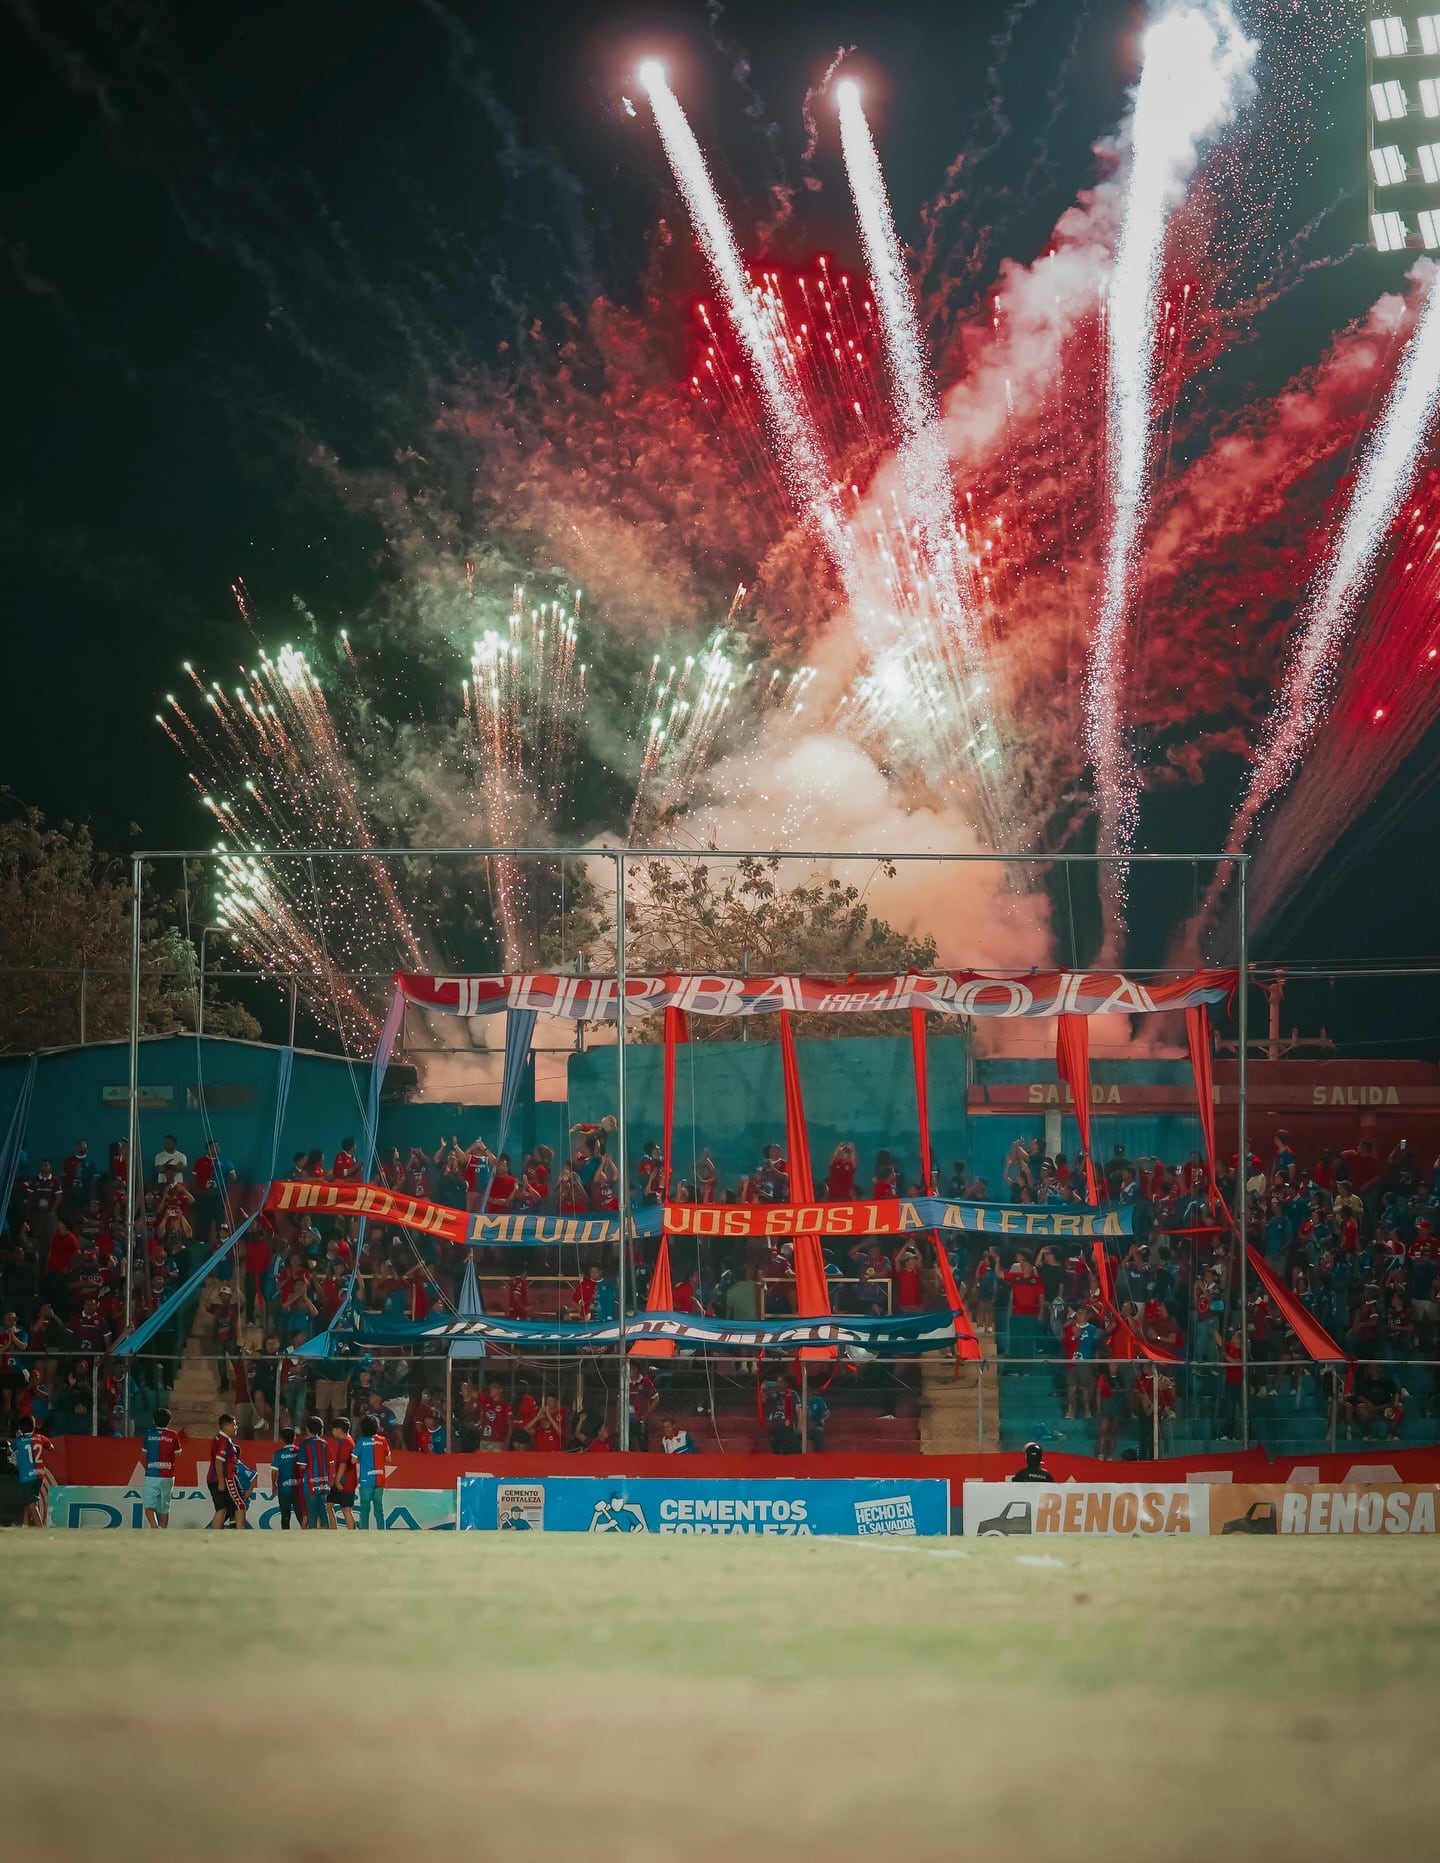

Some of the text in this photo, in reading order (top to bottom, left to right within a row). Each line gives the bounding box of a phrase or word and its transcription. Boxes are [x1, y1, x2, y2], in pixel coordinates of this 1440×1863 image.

[434, 975, 805, 1019] TURBA
[887, 974, 1158, 1016] ROJA
[1029, 1084, 1121, 1104] SALDA
[1313, 1086, 1400, 1104] SALIDA
[469, 1215, 527, 1242] MI
[664, 1207, 752, 1235] VOS
[765, 1206, 853, 1235] SOS
[862, 1202, 925, 1234] LA
[941, 1203, 1125, 1236] ALEGRIA
[24, 1443, 43, 1464] 12
[660, 1499, 808, 1521] CEMENTOS
[855, 1502, 913, 1524] HECHO EN
[1036, 1492, 1191, 1533] RENOSA
[1281, 1492, 1436, 1534] RENOSA
[858, 1518, 916, 1535] EL SALVADOR
